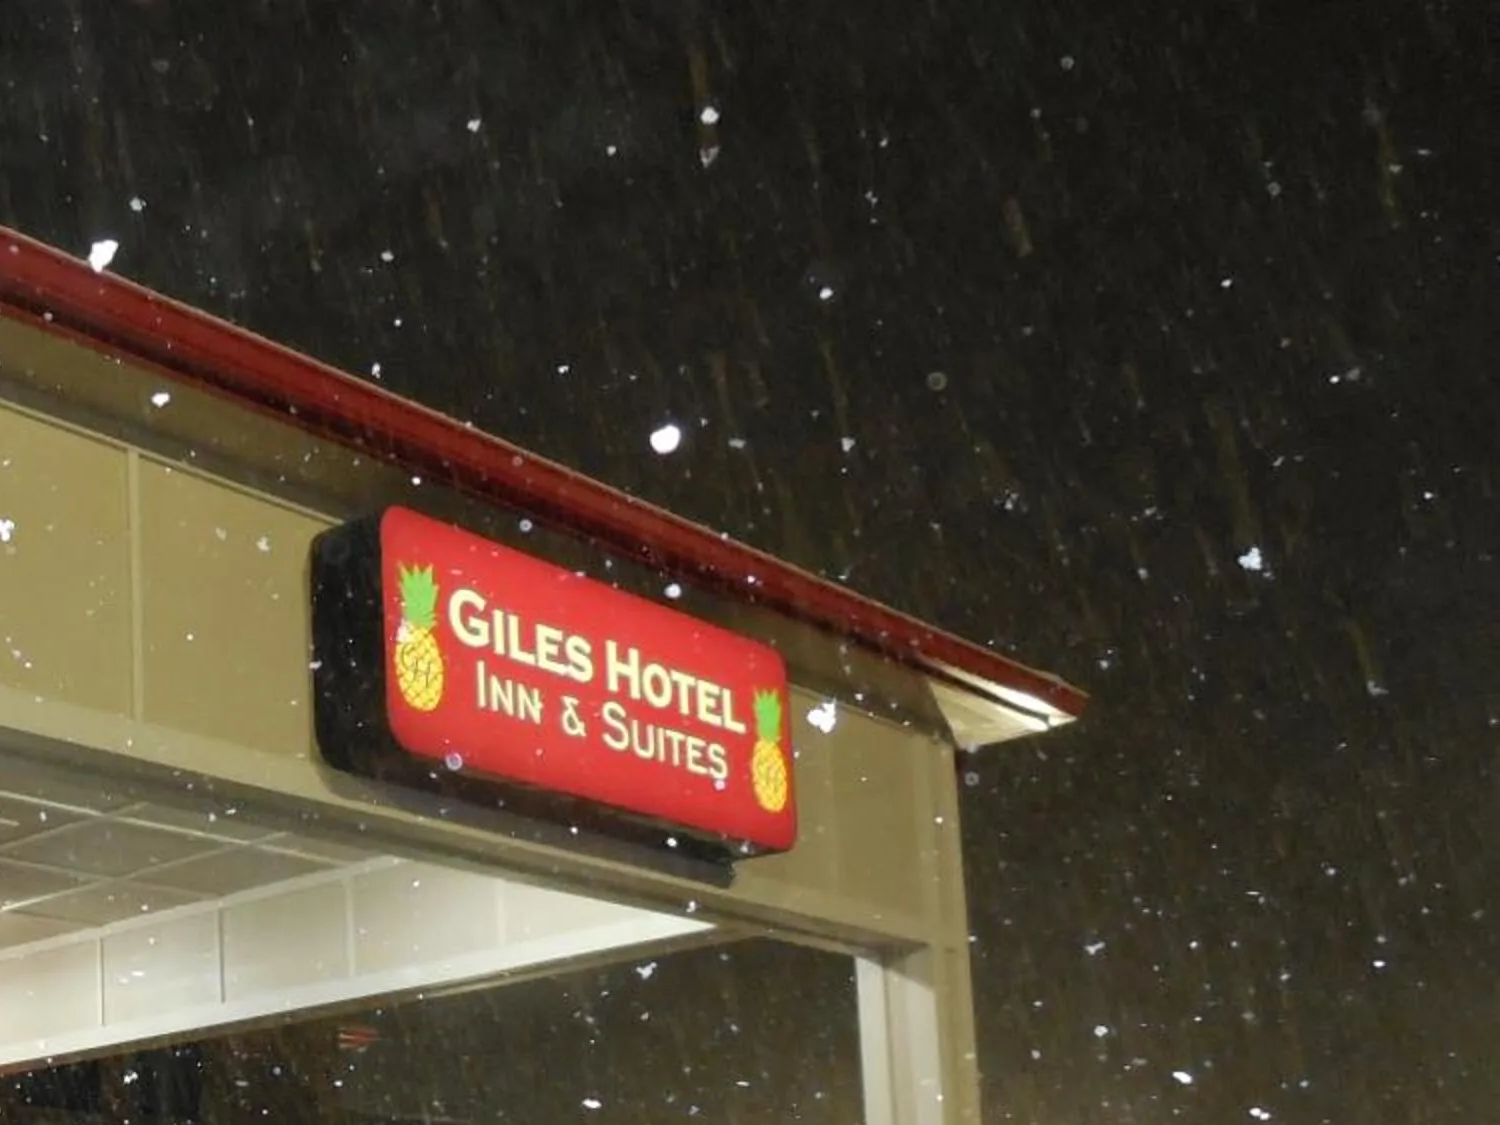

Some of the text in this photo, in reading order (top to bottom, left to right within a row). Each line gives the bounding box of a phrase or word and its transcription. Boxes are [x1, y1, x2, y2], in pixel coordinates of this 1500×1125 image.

[448, 589, 746, 733] GILES HOTEL
[477, 662, 543, 724] INN
[561, 696, 586, 737] &
[603, 702, 729, 780] SUITES
